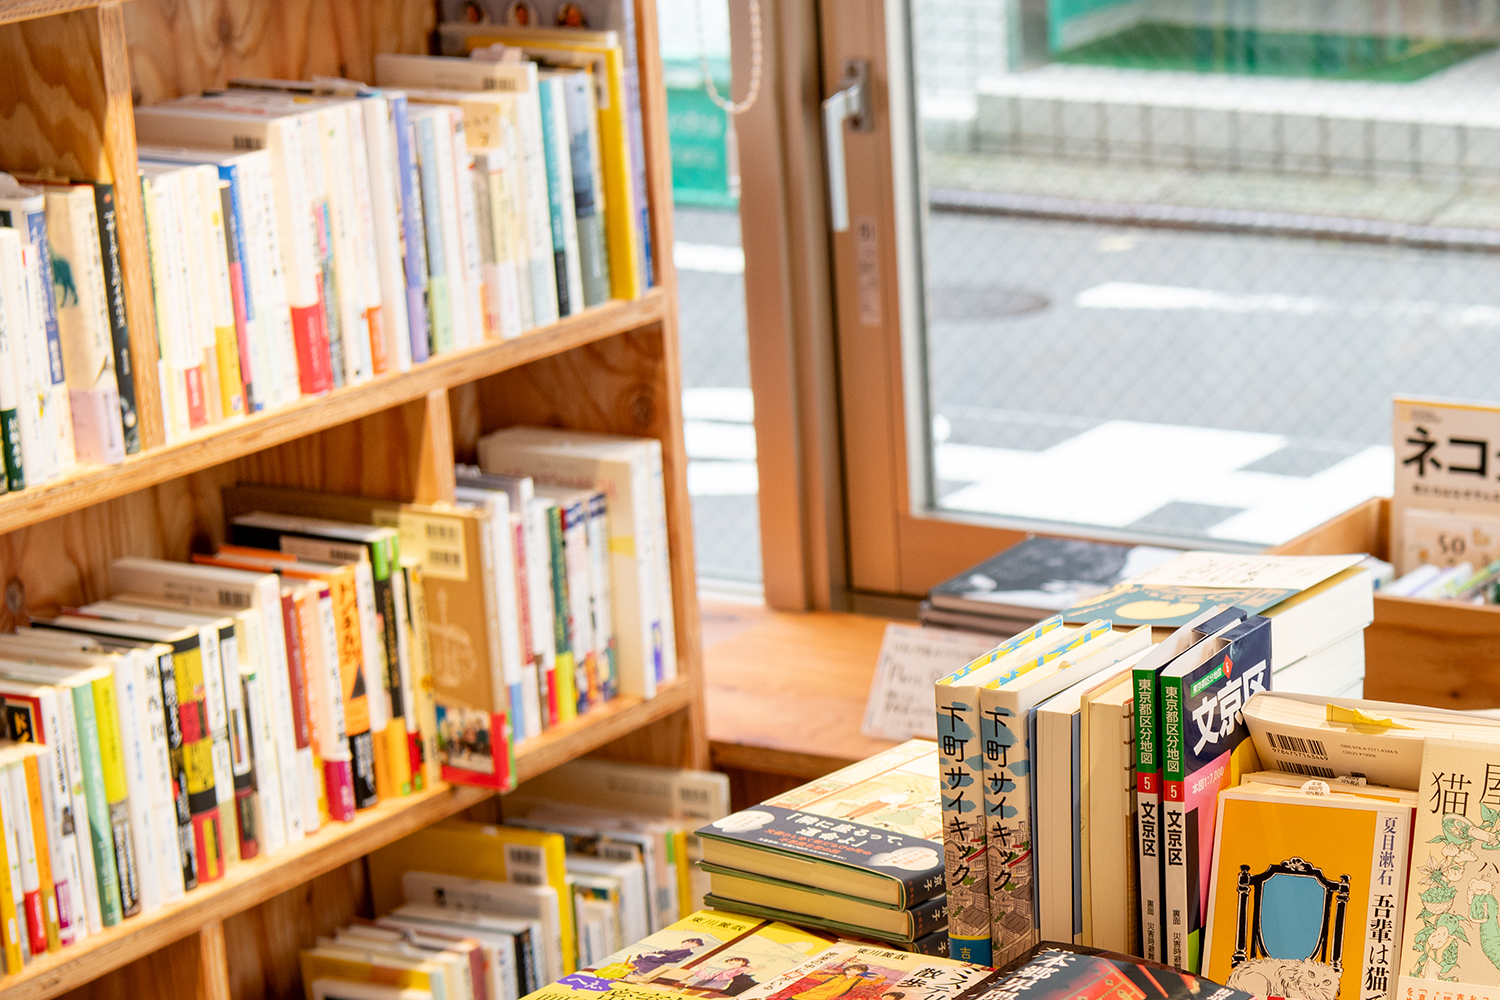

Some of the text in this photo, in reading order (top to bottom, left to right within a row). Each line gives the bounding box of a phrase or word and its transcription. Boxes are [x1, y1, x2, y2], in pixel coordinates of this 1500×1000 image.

[1137, 678, 1153, 765] 東京都区分地図
[1192, 659, 1267, 756] 文京区
[1165, 686, 1180, 773] 東京都区分地図
[1272, 748, 1329, 761] 9784757143449
[941, 705, 973, 887] 下町サイキック
[984, 709, 1012, 892] 下町サイキック
[1143, 776, 1151, 790] 5
[1170, 785, 1177, 798] 5
[1140, 801, 1156, 857] 文京区
[1167, 810, 1183, 866] 文京区
[1377, 815, 1399, 887] 夏目漱石
[691, 916, 747, 932] 東川篤哉
[1147, 900, 1154, 915] 裏面
[1172, 909, 1181, 926] 裏面
[857, 948, 909, 960] 東川篤哉
[898, 967, 946, 988] 散歩
